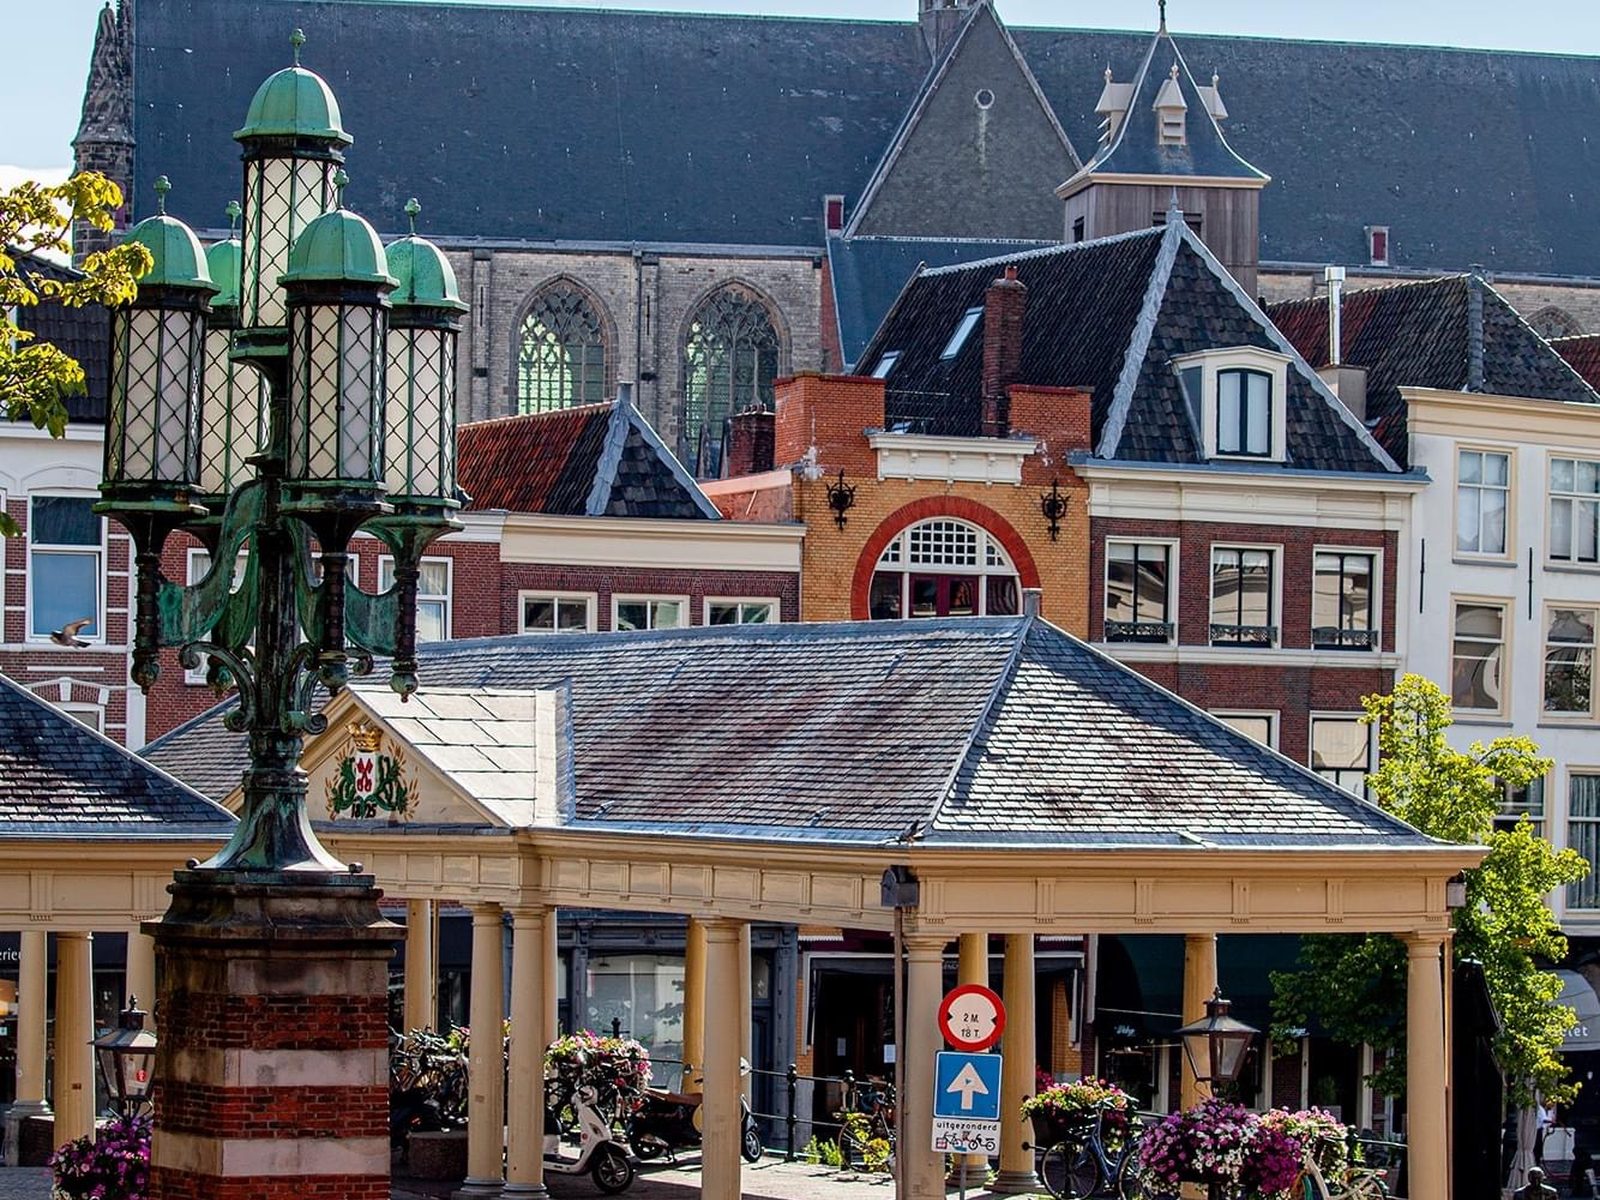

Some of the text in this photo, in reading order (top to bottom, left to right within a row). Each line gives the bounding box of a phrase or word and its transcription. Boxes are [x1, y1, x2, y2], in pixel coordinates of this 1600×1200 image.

[963, 1013, 969, 1023] 2
[961, 1029, 971, 1038] 18
[936, 1122, 998, 1131] uitgezonderd
